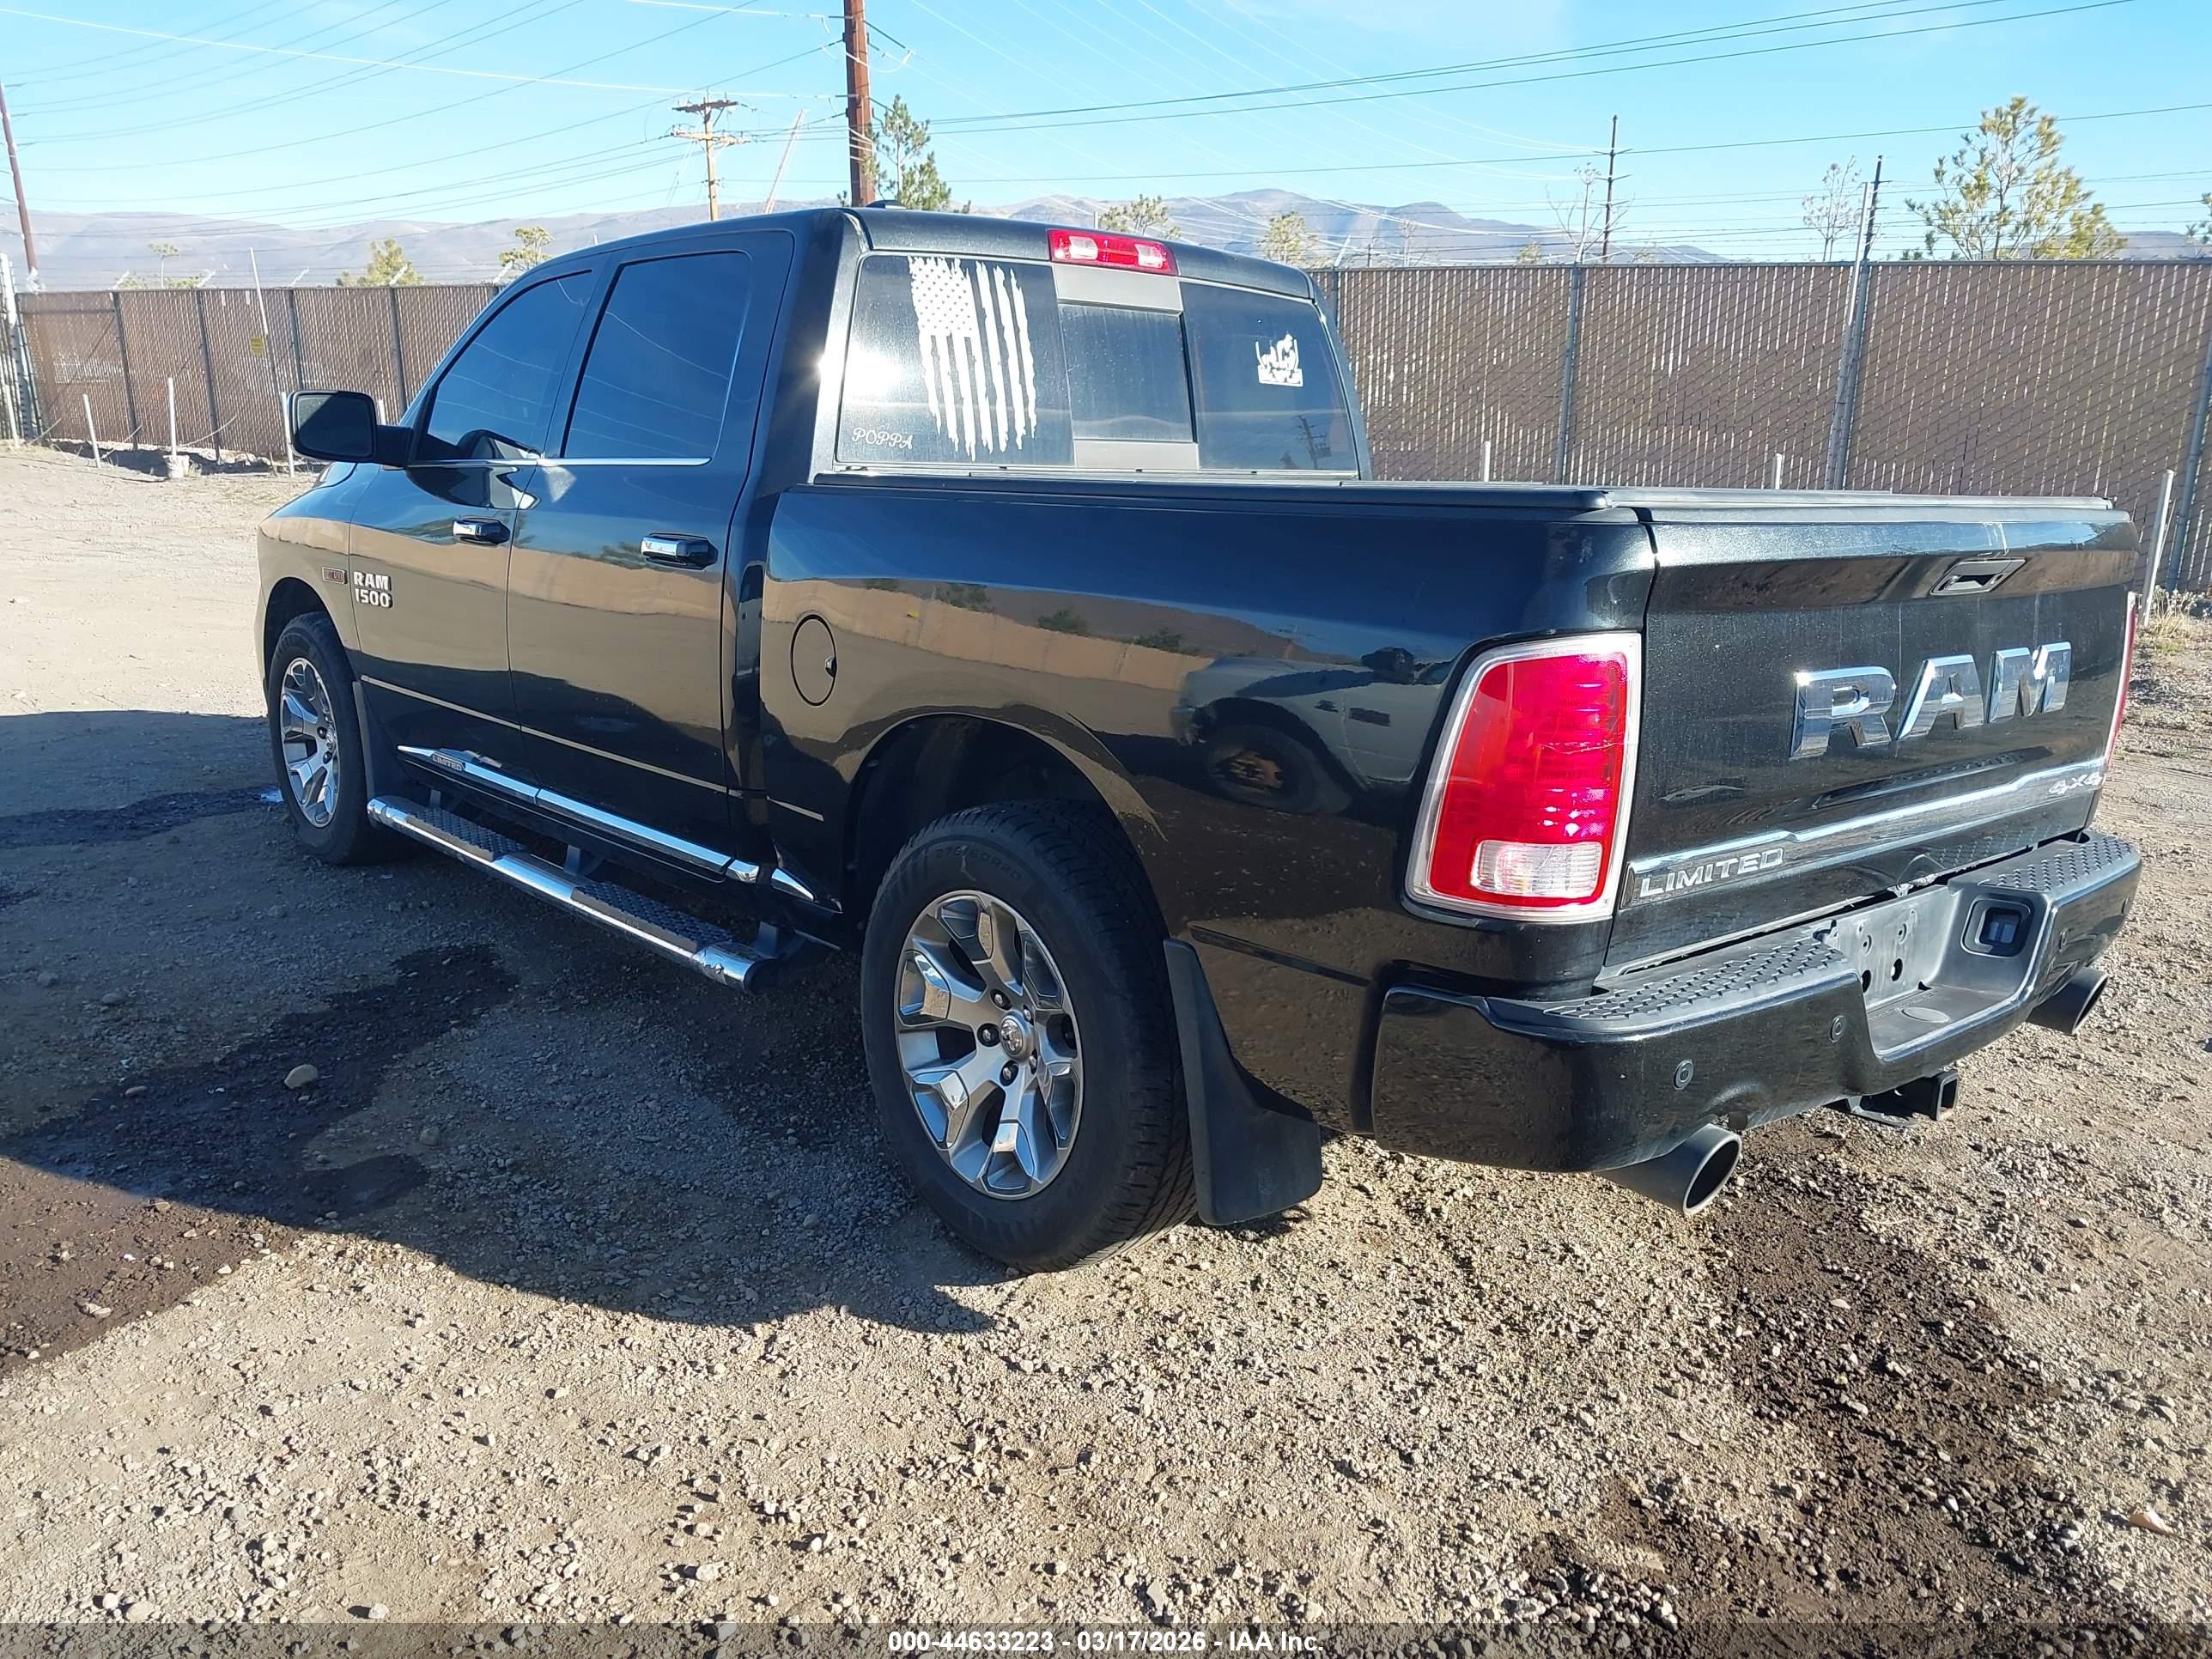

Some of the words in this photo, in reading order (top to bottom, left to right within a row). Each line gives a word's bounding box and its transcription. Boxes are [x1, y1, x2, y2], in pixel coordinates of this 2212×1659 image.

[852, 427, 913, 450] POPPA
[354, 571, 391, 591] RAM
[355, 587, 392, 608] 1500
[1790, 641, 2072, 759] RAM
[1639, 848, 1784, 898] LIMITED
